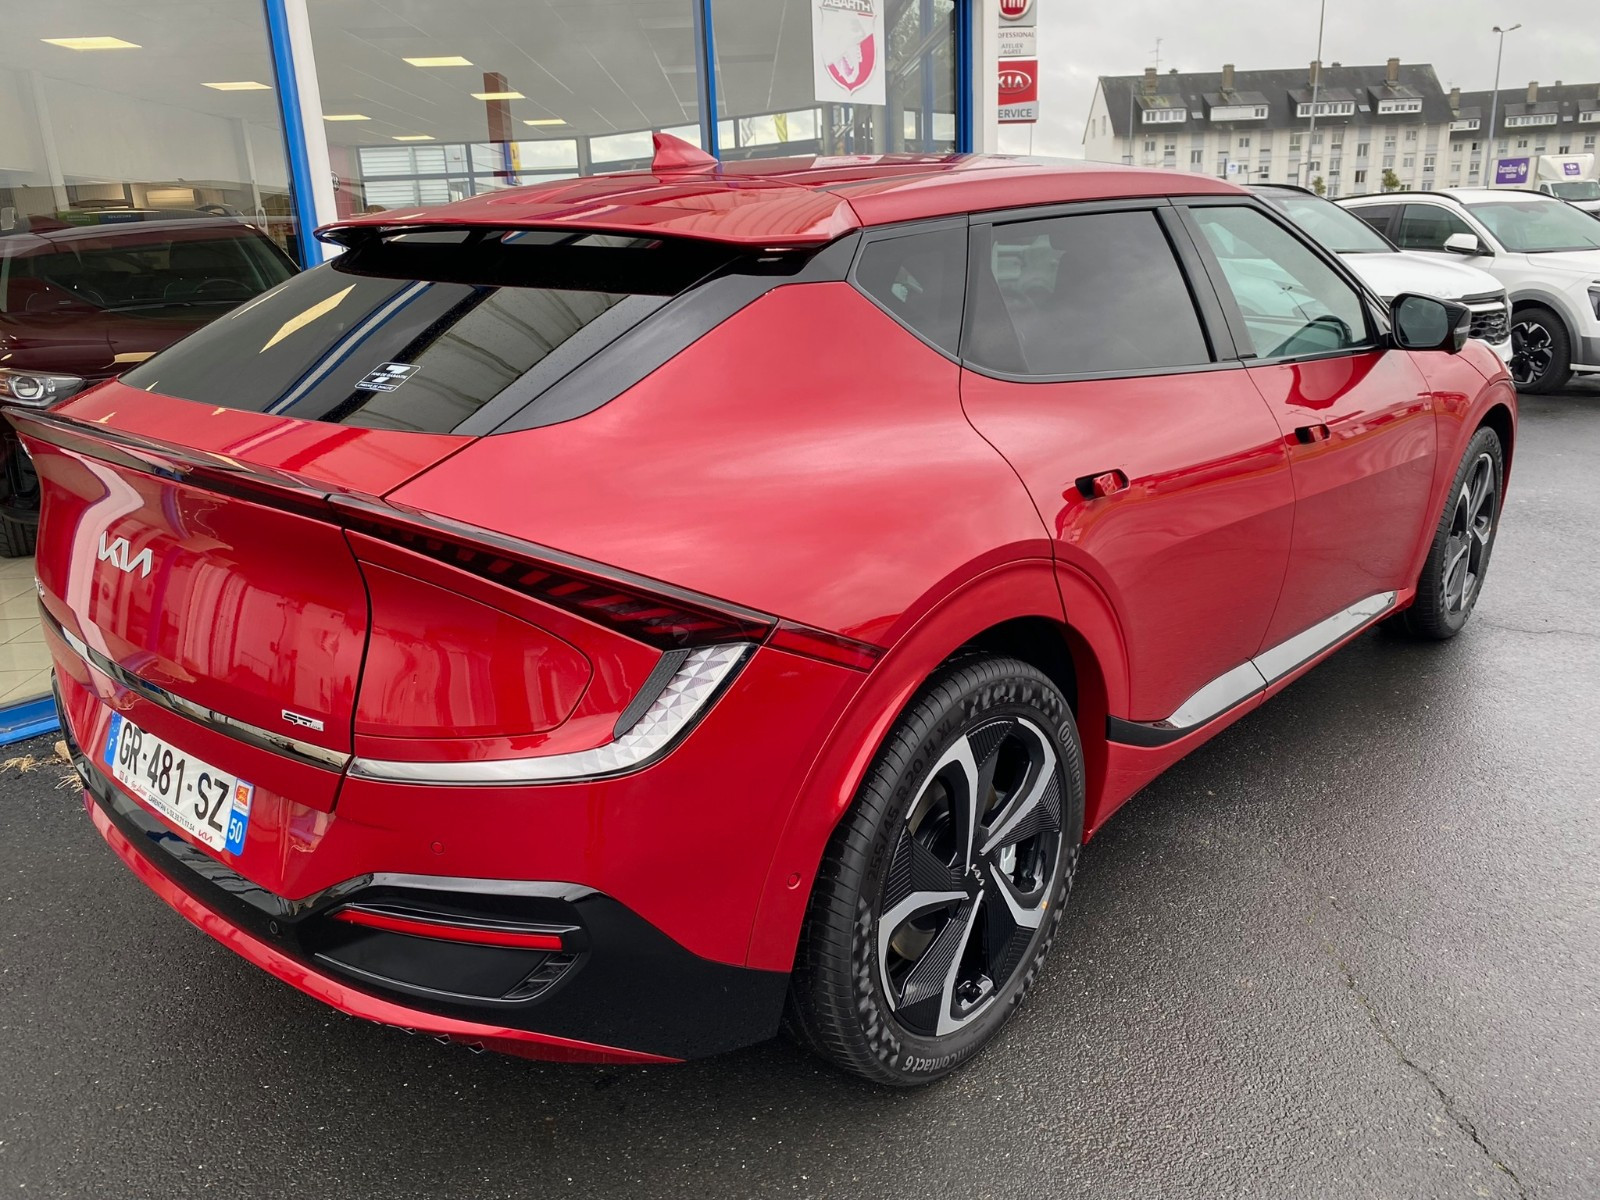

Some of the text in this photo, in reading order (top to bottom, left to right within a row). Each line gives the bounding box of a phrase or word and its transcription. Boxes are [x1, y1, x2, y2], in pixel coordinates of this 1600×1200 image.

[998, 109, 1033, 118] ERVICE
[97, 530, 154, 579] KIA
[119, 721, 230, 833] GR-481-SZ
[228, 817, 243, 844] 50
